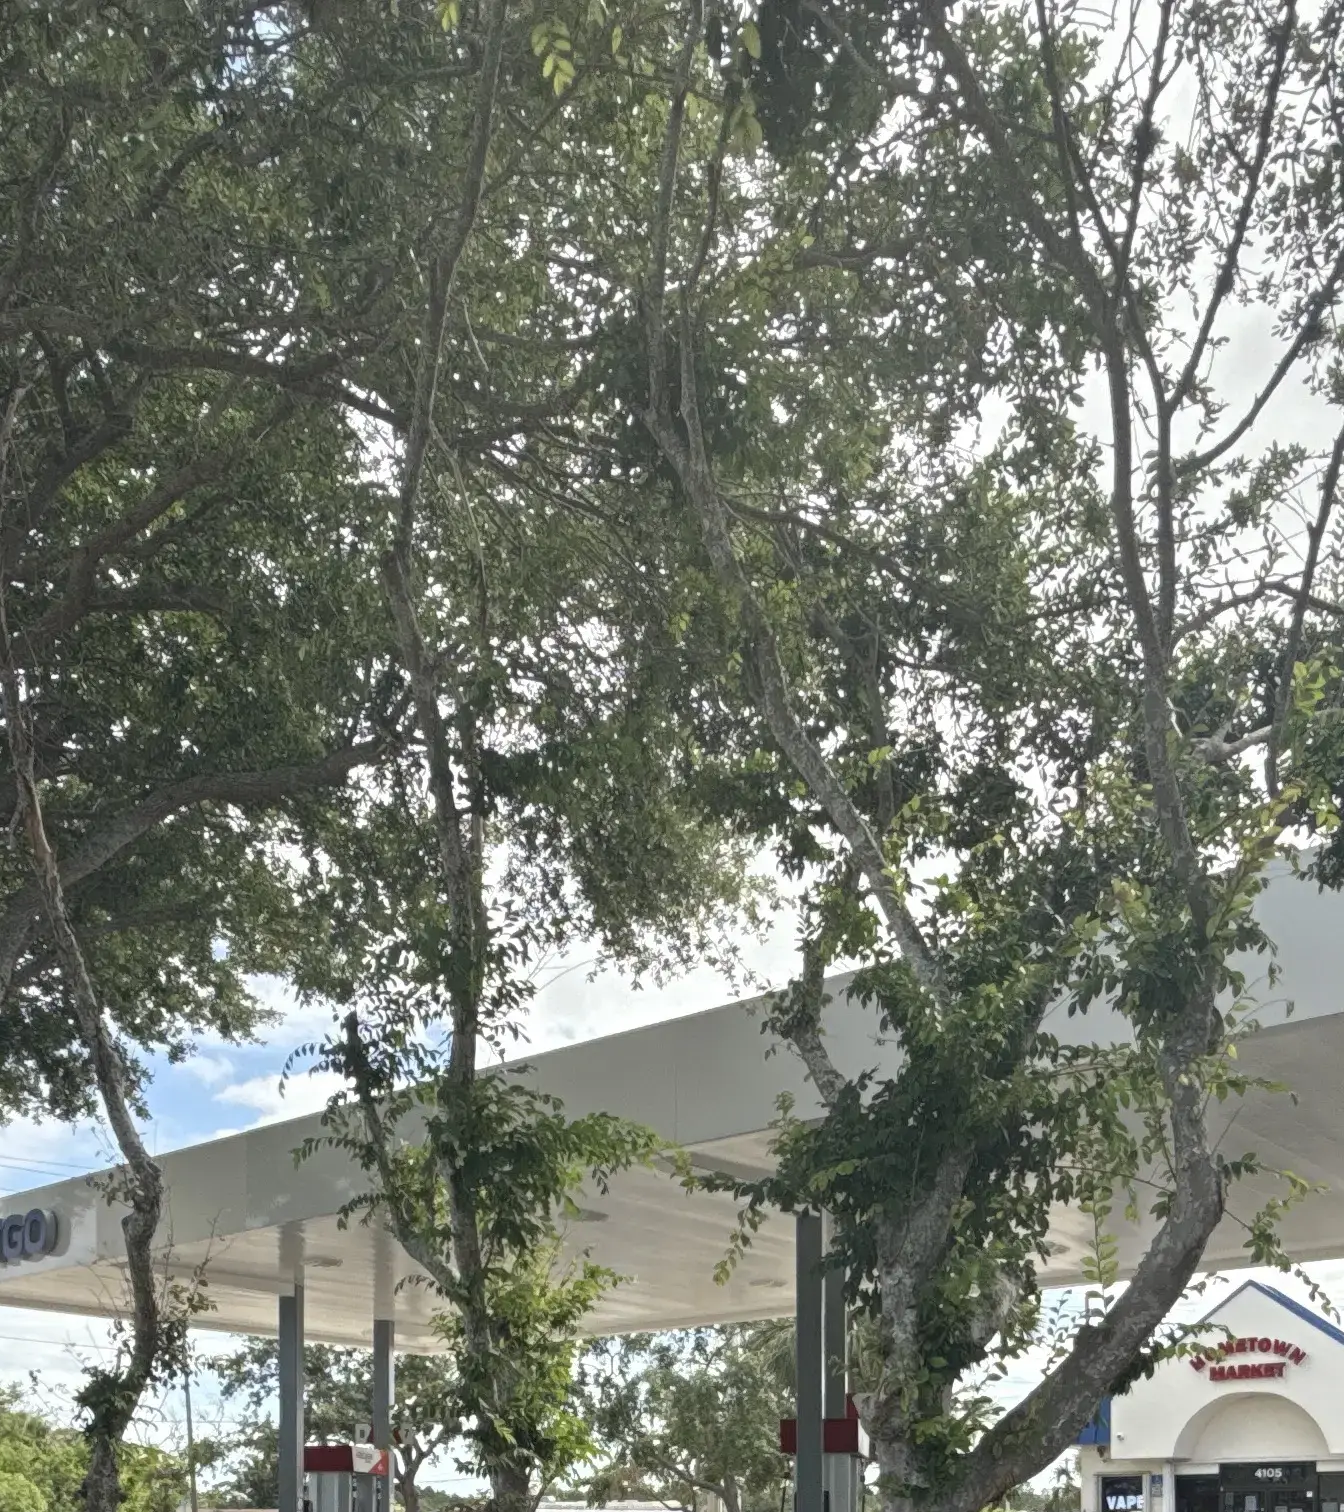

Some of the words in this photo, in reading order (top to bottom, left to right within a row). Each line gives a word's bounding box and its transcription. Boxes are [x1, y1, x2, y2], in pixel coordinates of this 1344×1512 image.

[1209, 1362, 1286, 1381] MARKET
[1254, 1467, 1283, 1478] 4105
[1106, 1494, 1144, 1510] VAPE
